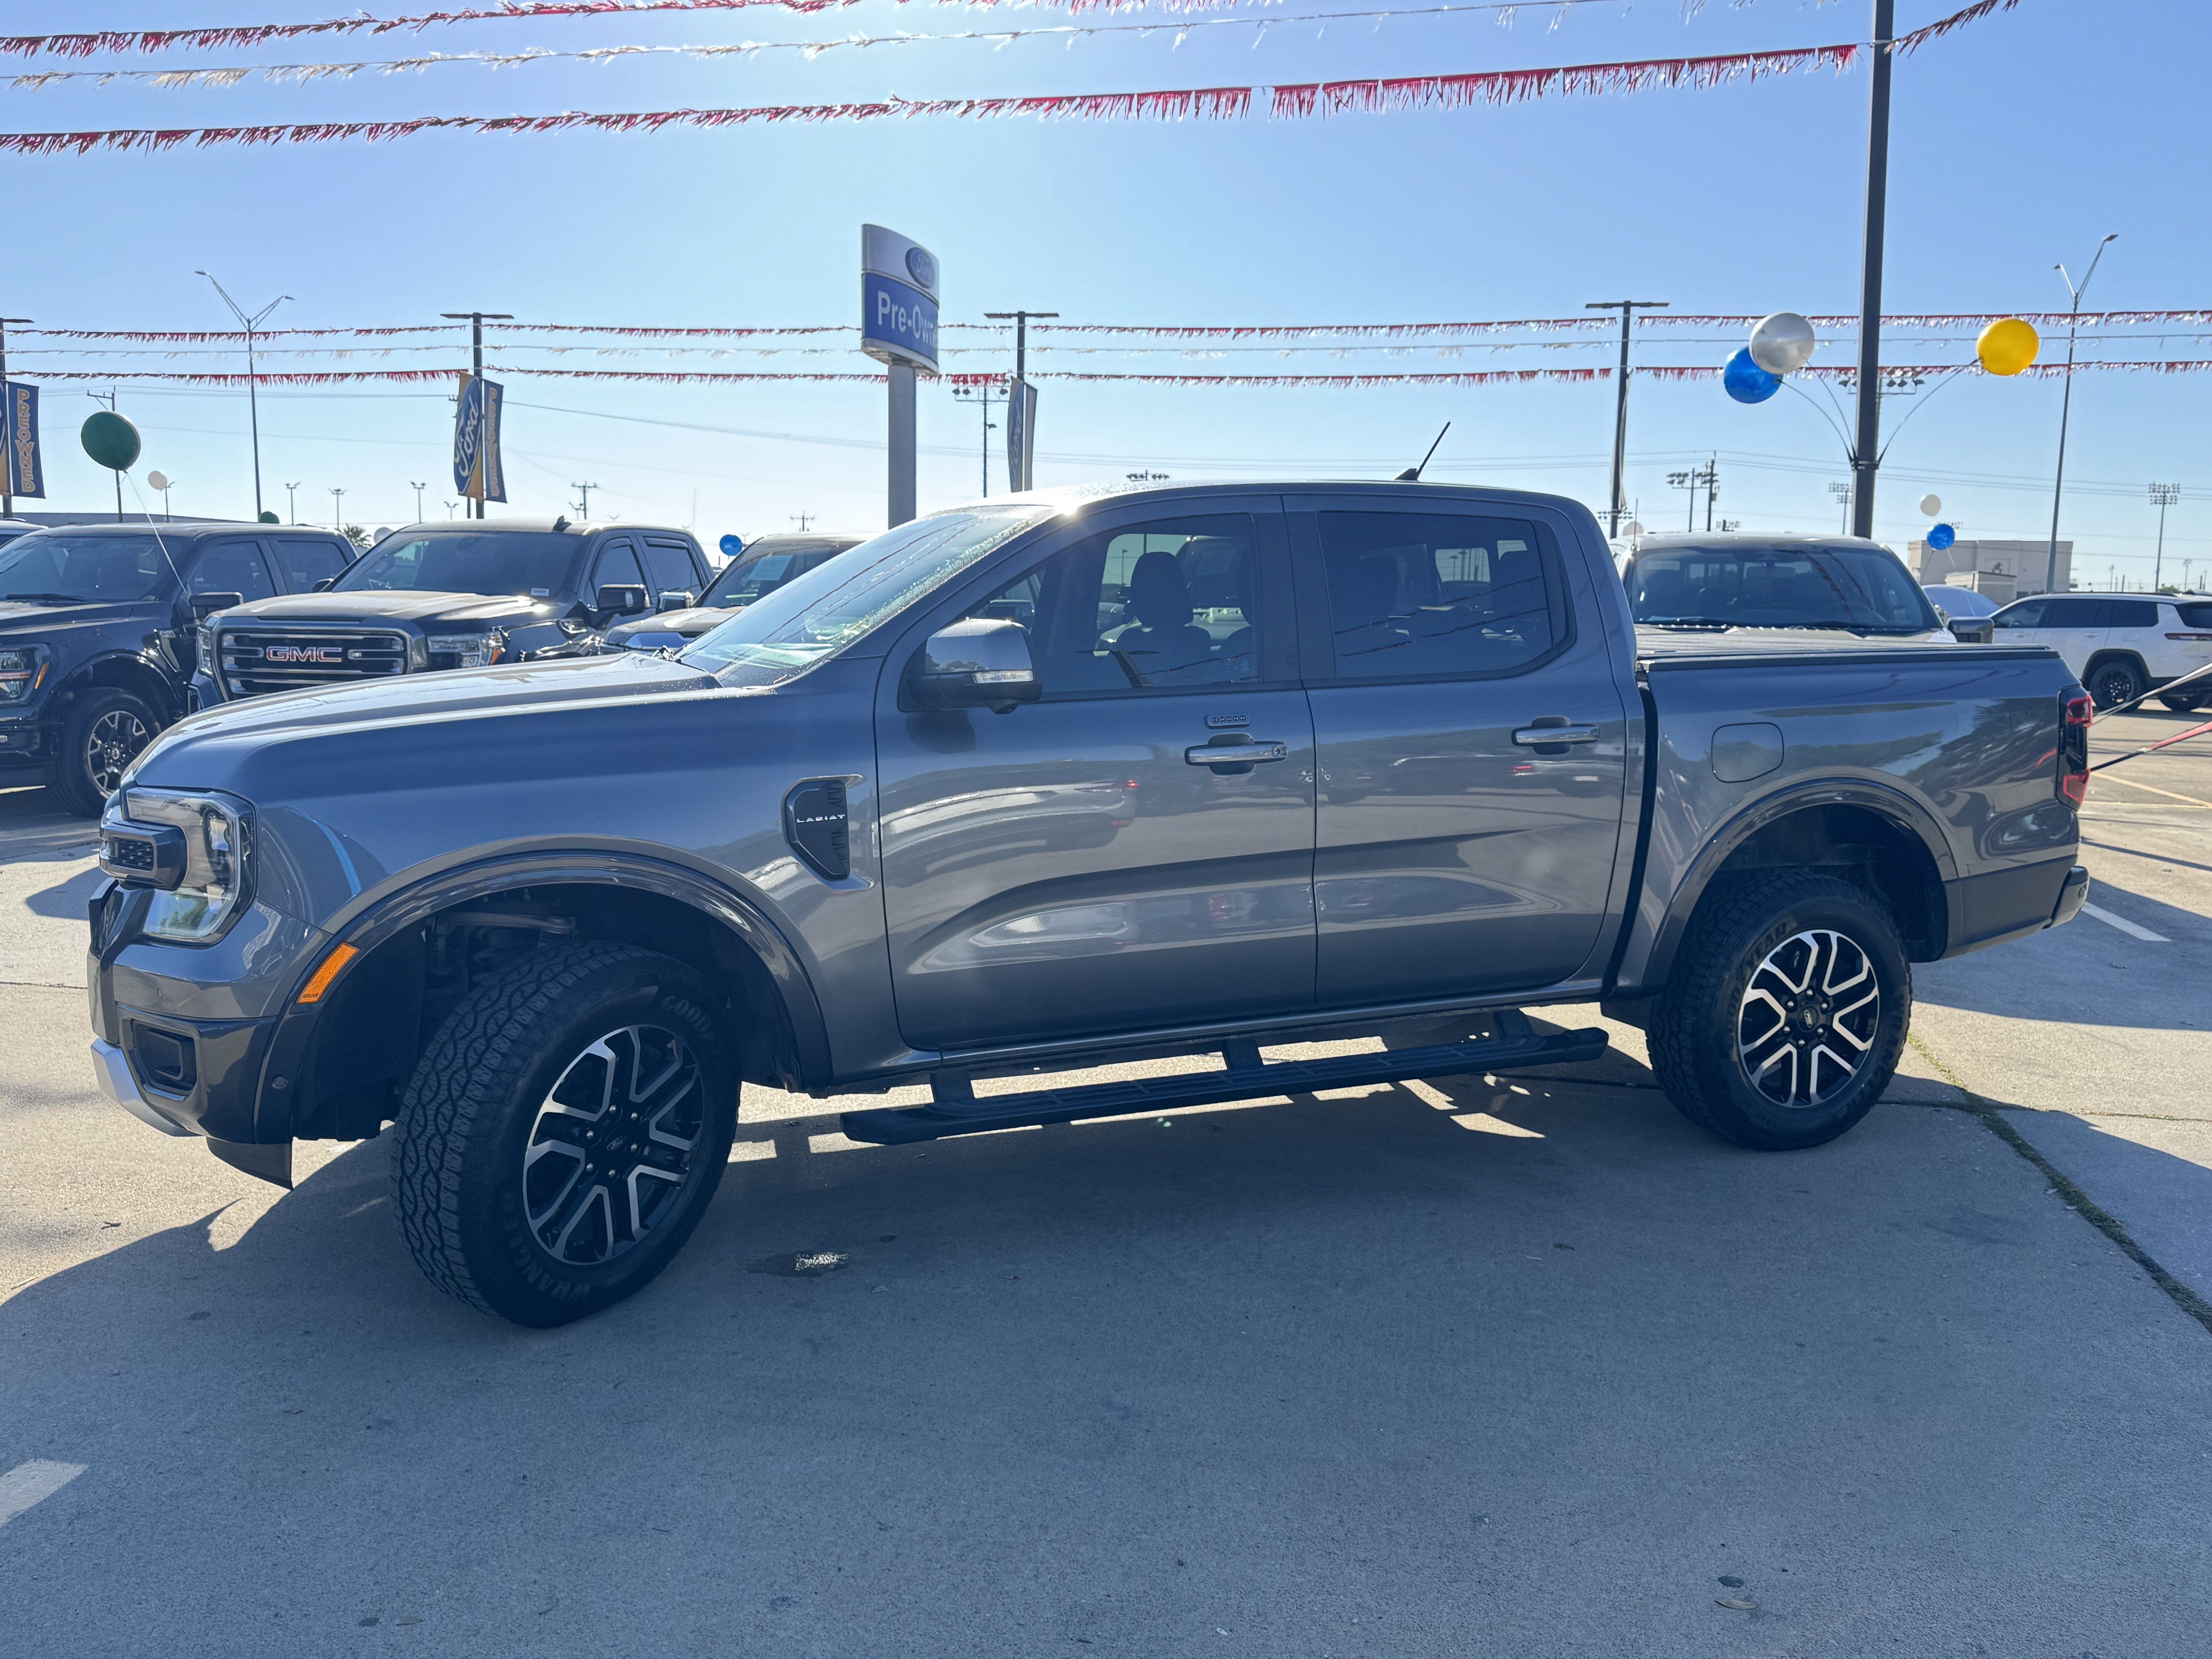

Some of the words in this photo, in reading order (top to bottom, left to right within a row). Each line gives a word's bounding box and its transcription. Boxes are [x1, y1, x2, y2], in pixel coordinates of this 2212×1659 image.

[878, 291, 935, 348] Pre-Own
[15, 388, 35, 492] PREOWNED
[454, 394, 479, 477] Ford
[486, 387, 500, 496] PREOWNED
[266, 646, 342, 662] GMC
[796, 814, 845, 823] LARIAT
